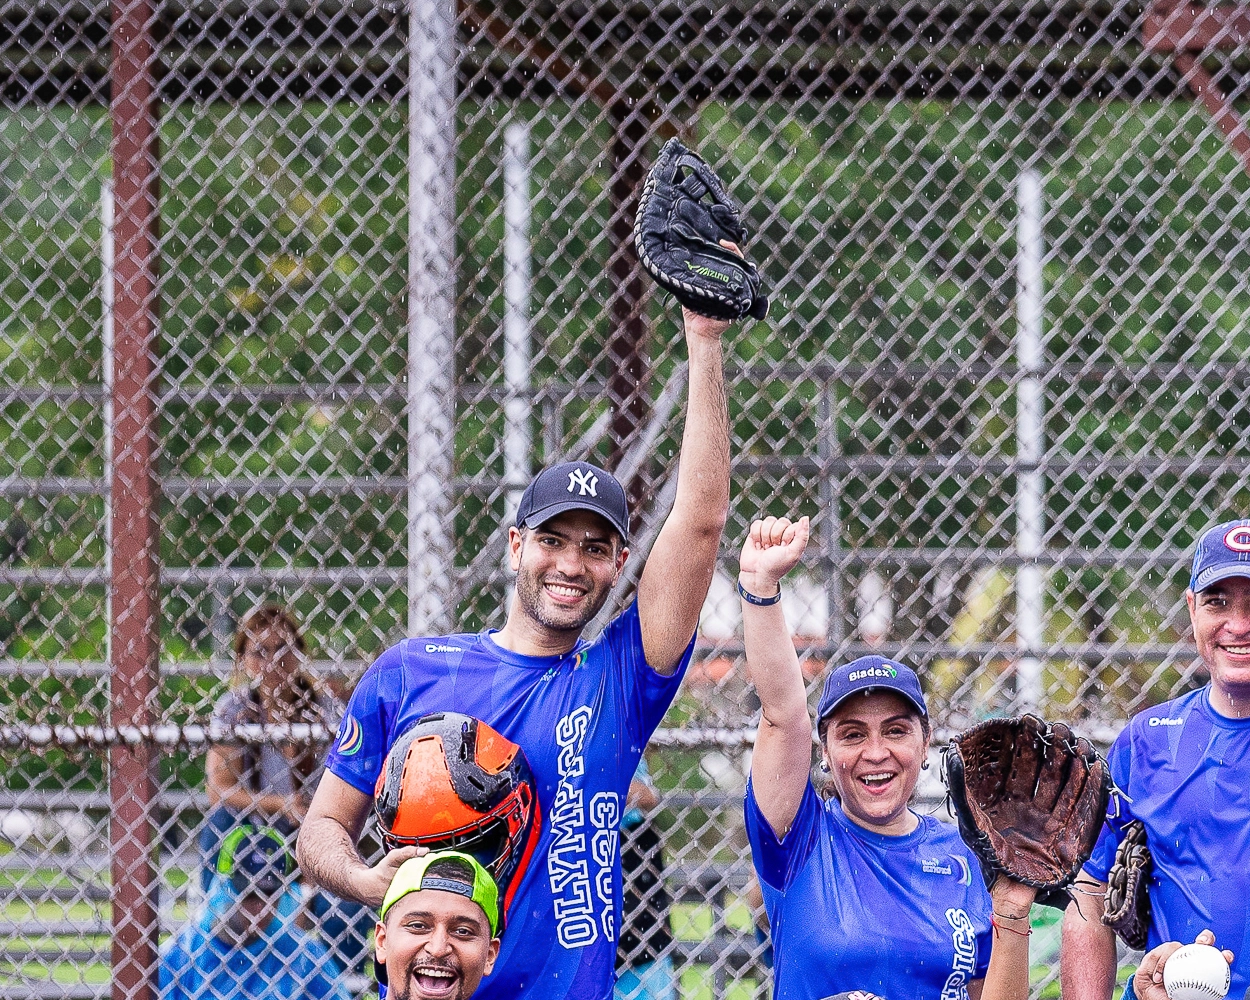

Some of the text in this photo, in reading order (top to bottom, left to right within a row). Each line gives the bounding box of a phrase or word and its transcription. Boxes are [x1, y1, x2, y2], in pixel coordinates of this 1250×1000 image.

[566, 467, 599, 498] NY
[848, 666, 890, 682] Bladex
[1148, 717, 1184, 727] D-Mark
